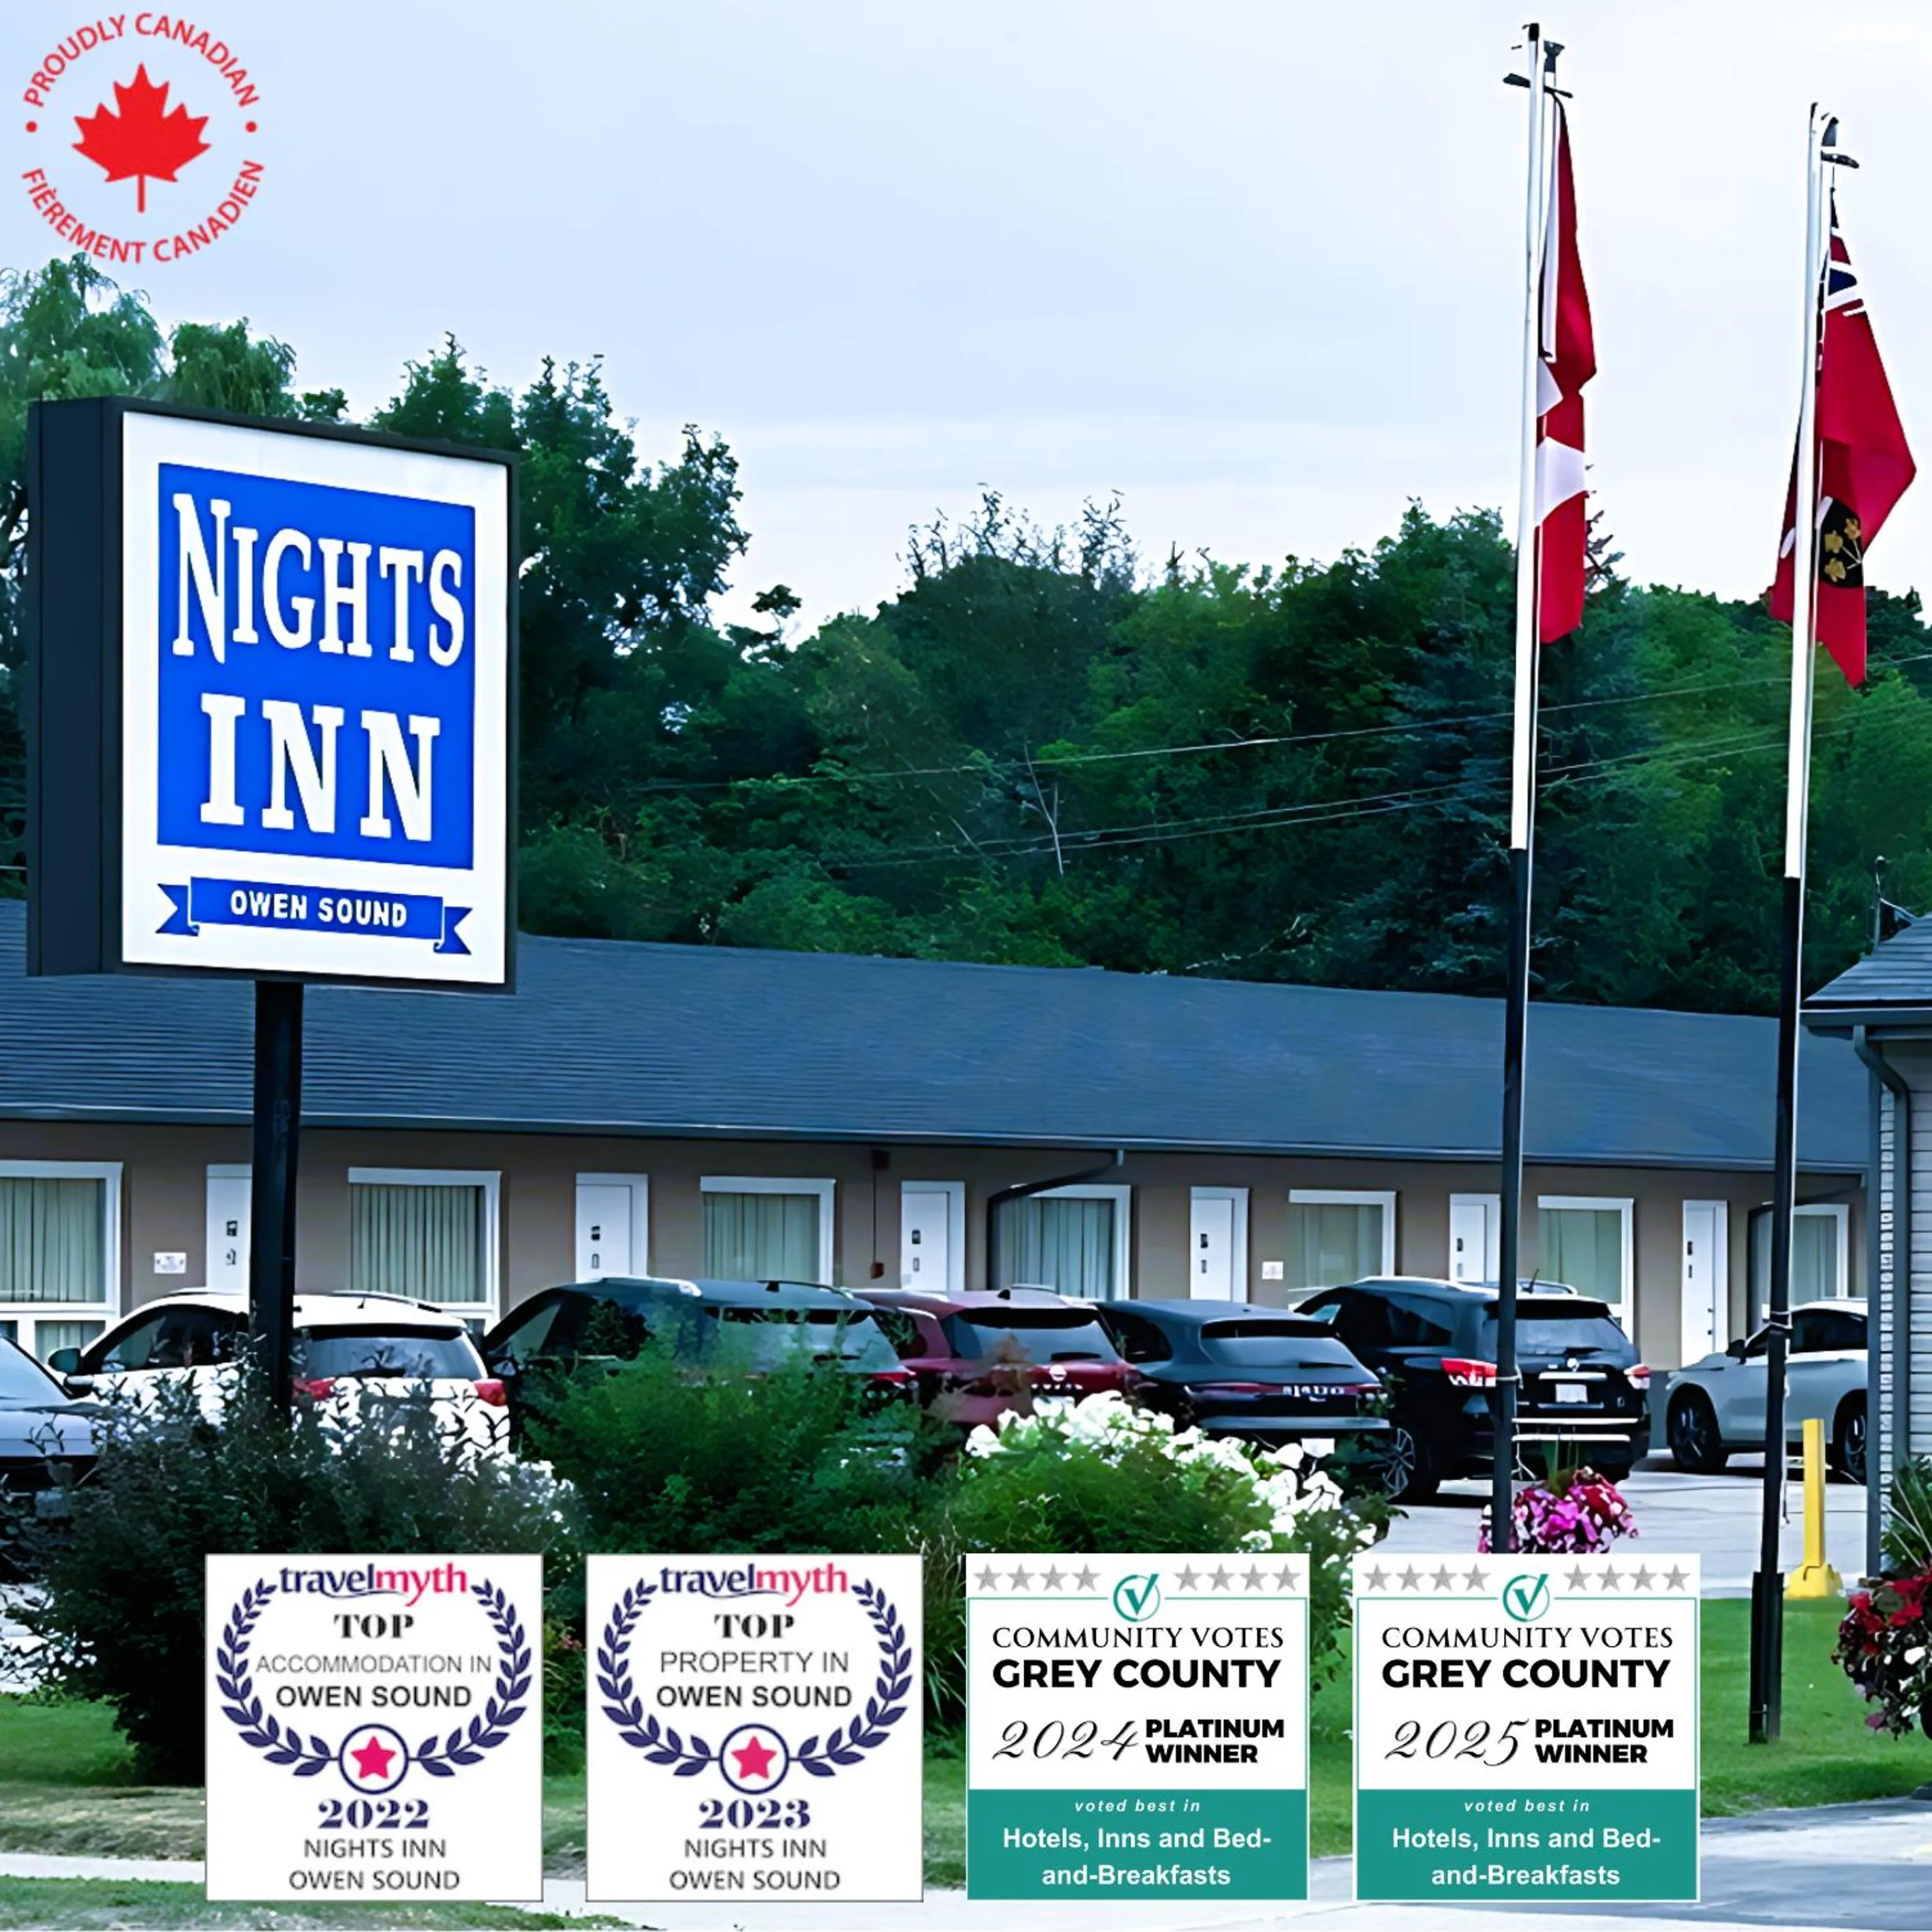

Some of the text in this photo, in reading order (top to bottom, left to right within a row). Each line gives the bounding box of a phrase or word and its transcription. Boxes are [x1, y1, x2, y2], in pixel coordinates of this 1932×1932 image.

[172, 493, 465, 666] NIGHTS
[200, 692, 440, 842] INN
[230, 889, 407, 928] OWEN SOUND
